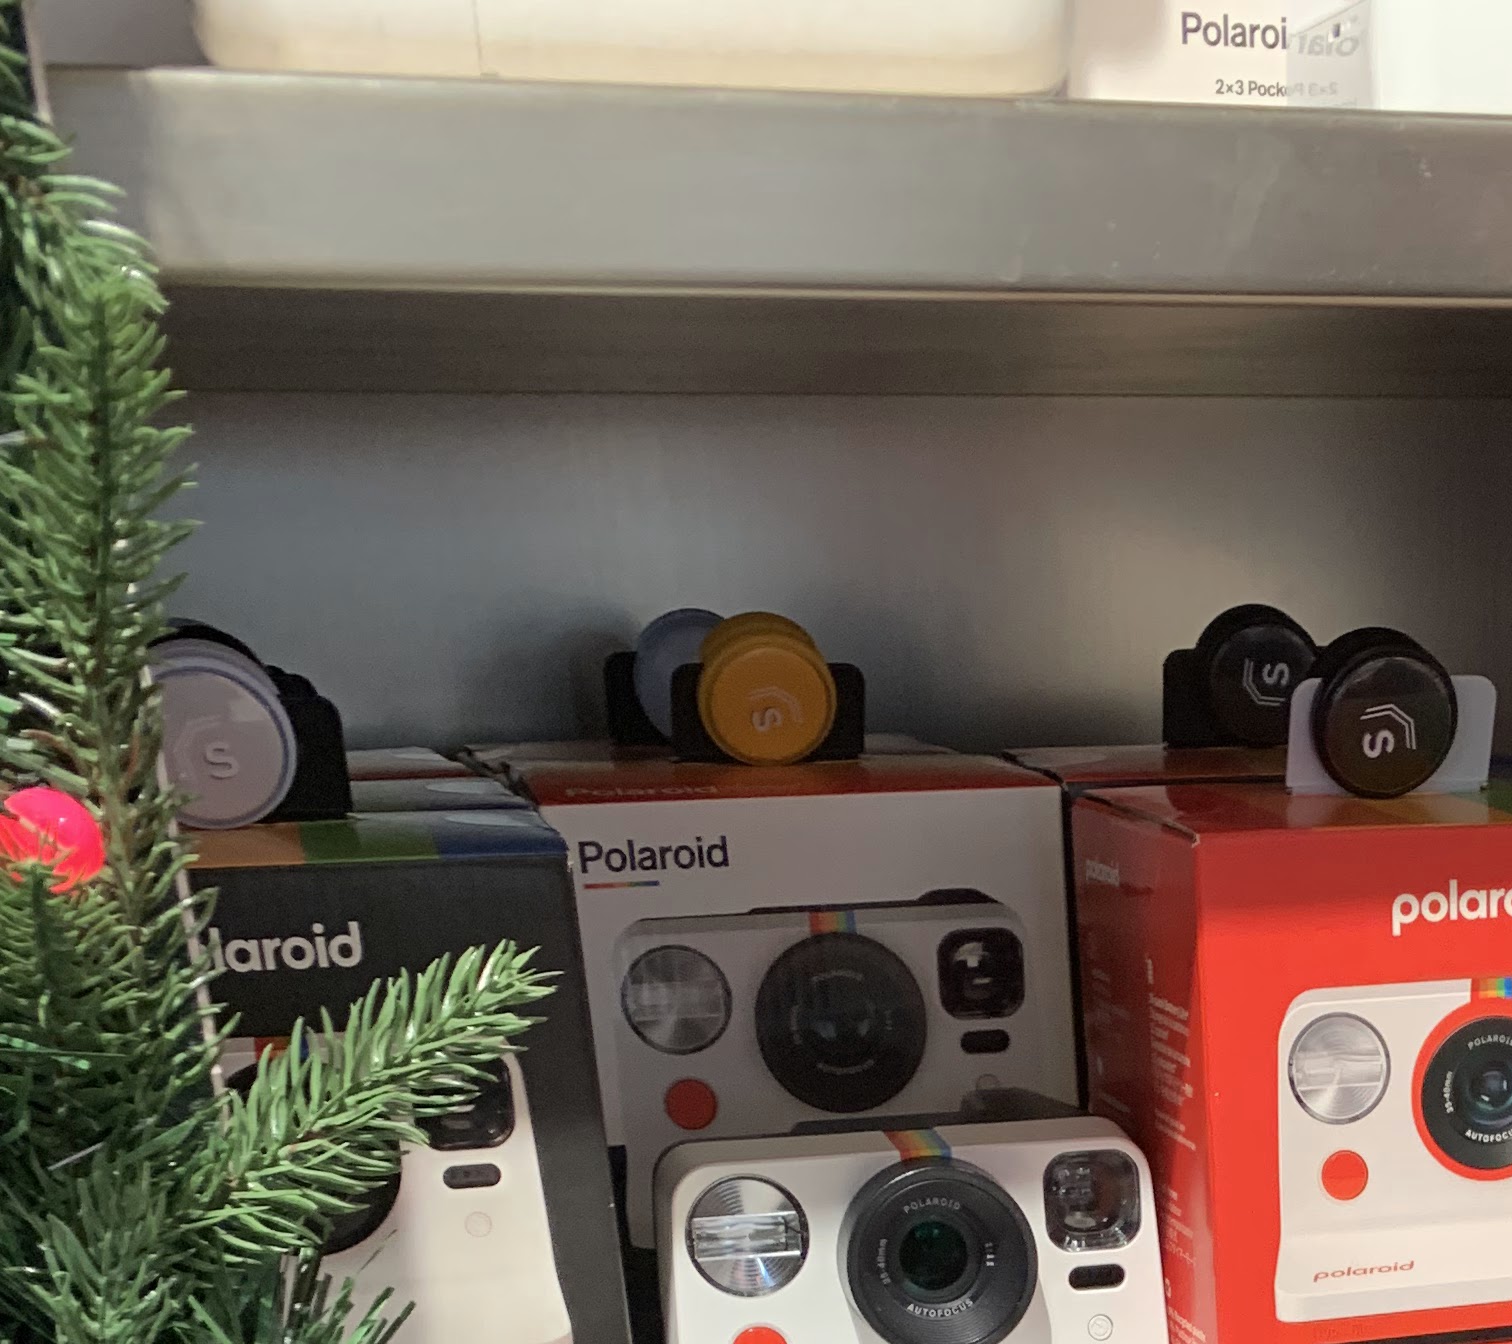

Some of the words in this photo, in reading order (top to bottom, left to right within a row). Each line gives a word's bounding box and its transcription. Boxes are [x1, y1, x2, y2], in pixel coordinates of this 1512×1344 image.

[1181, 11, 1287, 49] Polaroi
[1248, 79, 1288, 97] Pock
[578, 835, 730, 874] Polaroid
[903, 1197, 961, 1214] POLAROID
[1312, 1259, 1415, 1283] polaroid
[906, 1298, 974, 1318] AUTOFOCUS
